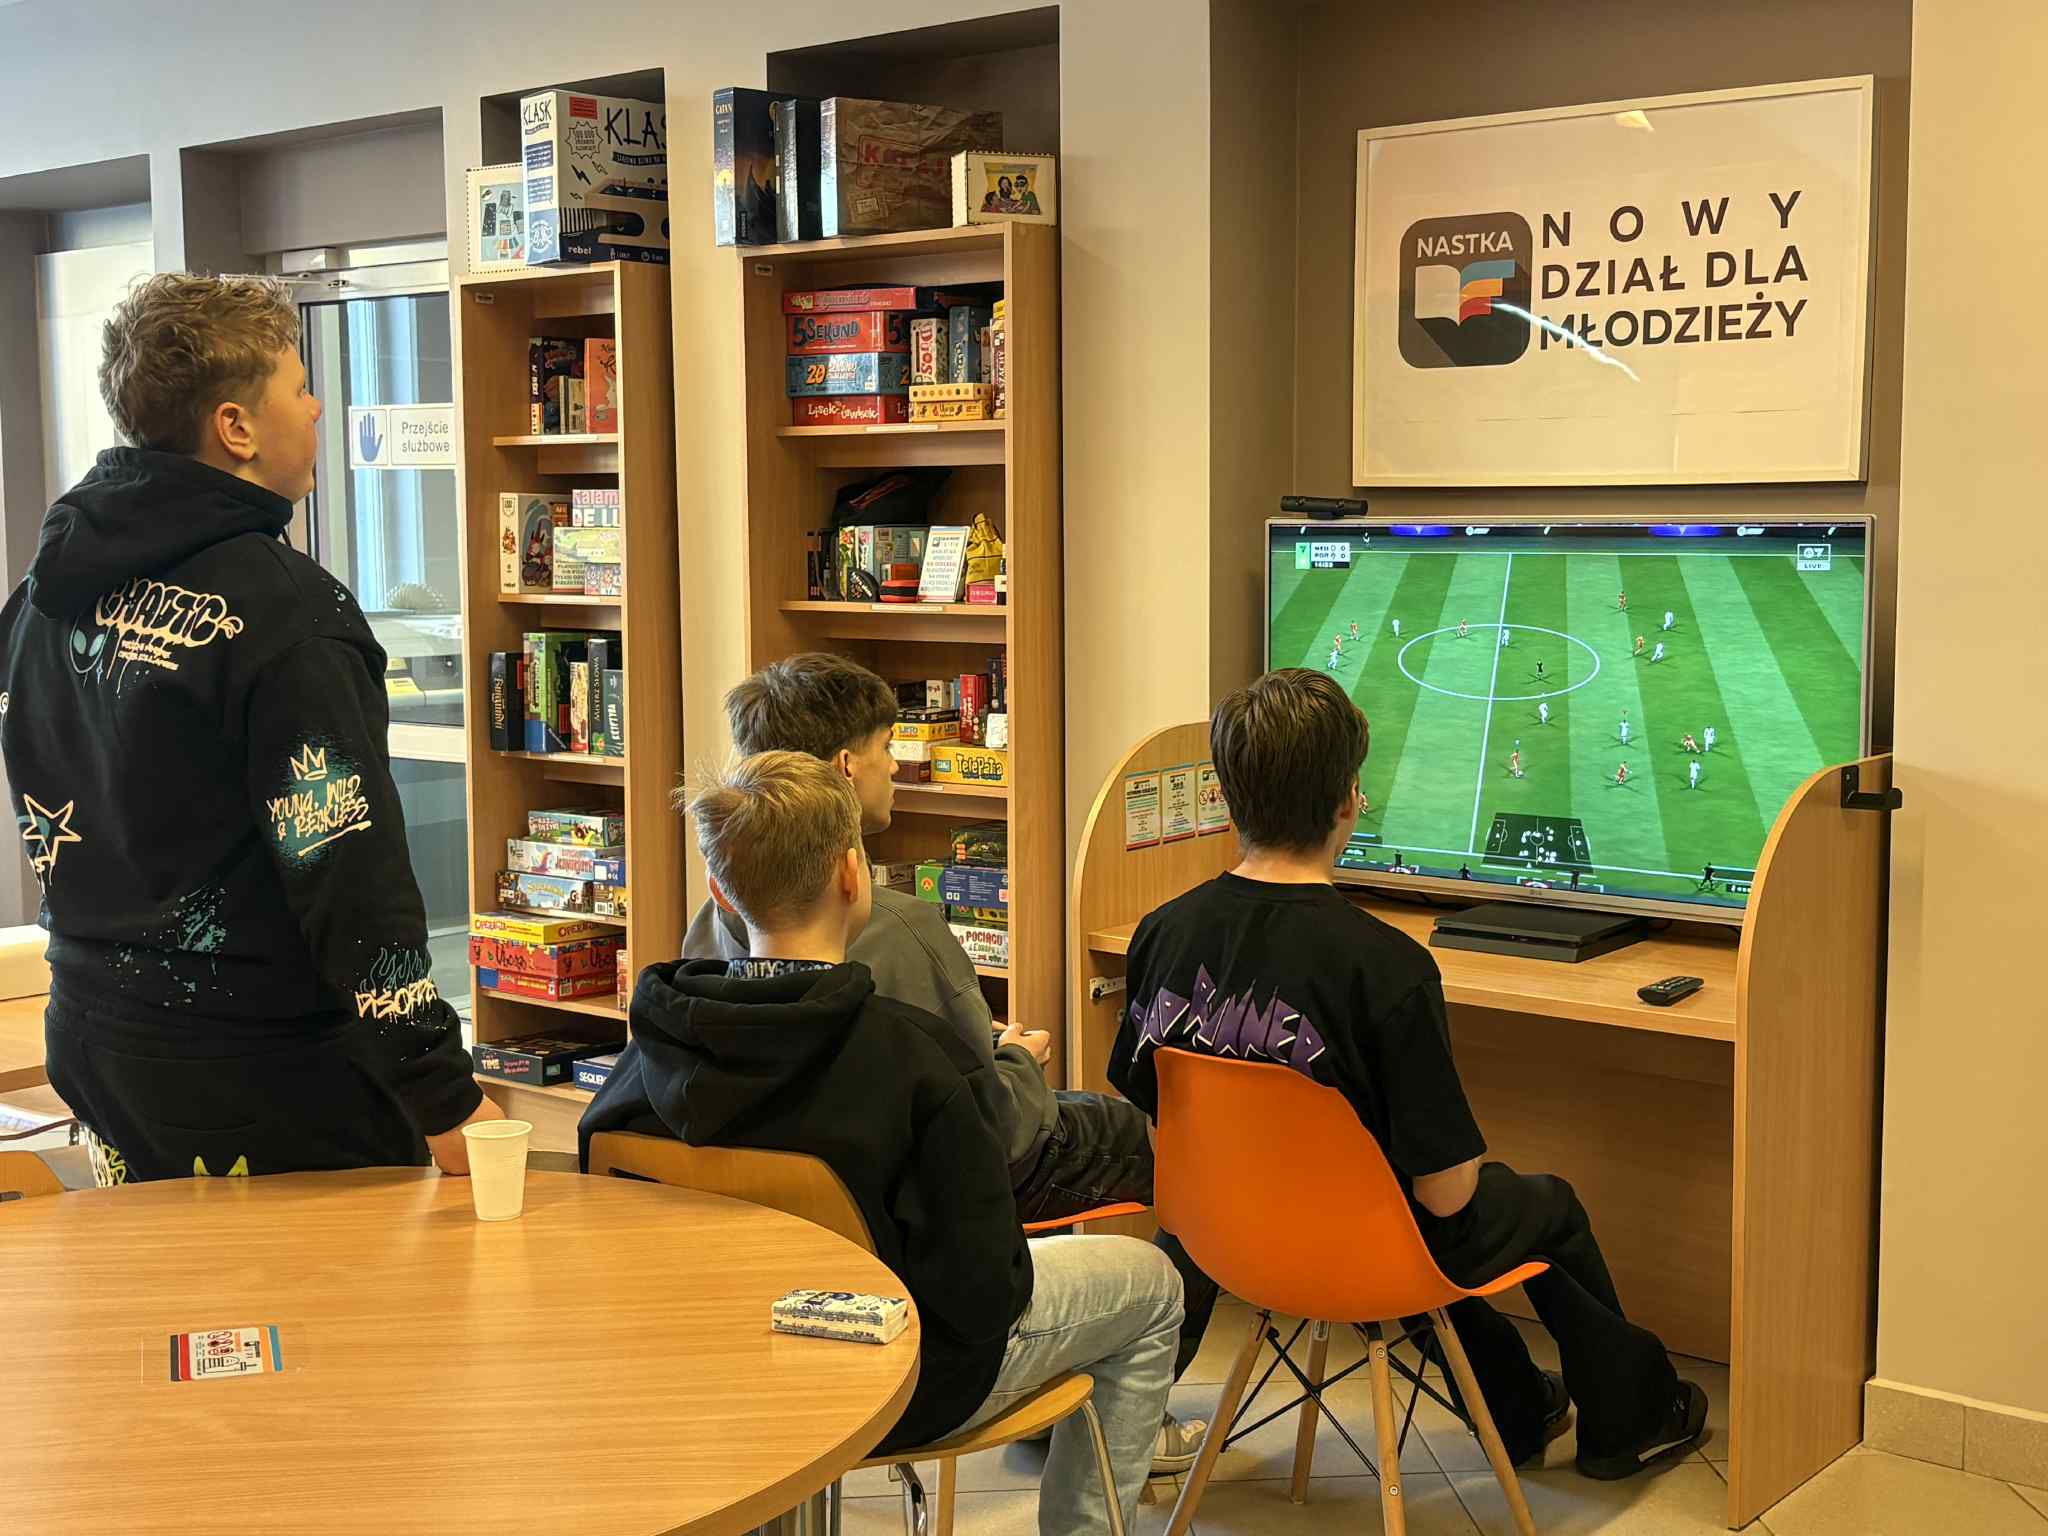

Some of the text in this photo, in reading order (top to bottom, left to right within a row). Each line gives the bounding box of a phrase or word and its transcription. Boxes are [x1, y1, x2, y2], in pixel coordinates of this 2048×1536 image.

[523, 99, 552, 126] KLASK
[1416, 231, 1514, 258] NASTKA
[1541, 245, 1809, 299] DZIAŁ DLA
[1540, 291, 1808, 351] MŁODZIEŻY
[806, 364, 827, 385] 20
[401, 420, 449, 437] Przejście
[401, 439, 450, 453] służbowe
[579, 1071, 607, 1085] SEQUE
